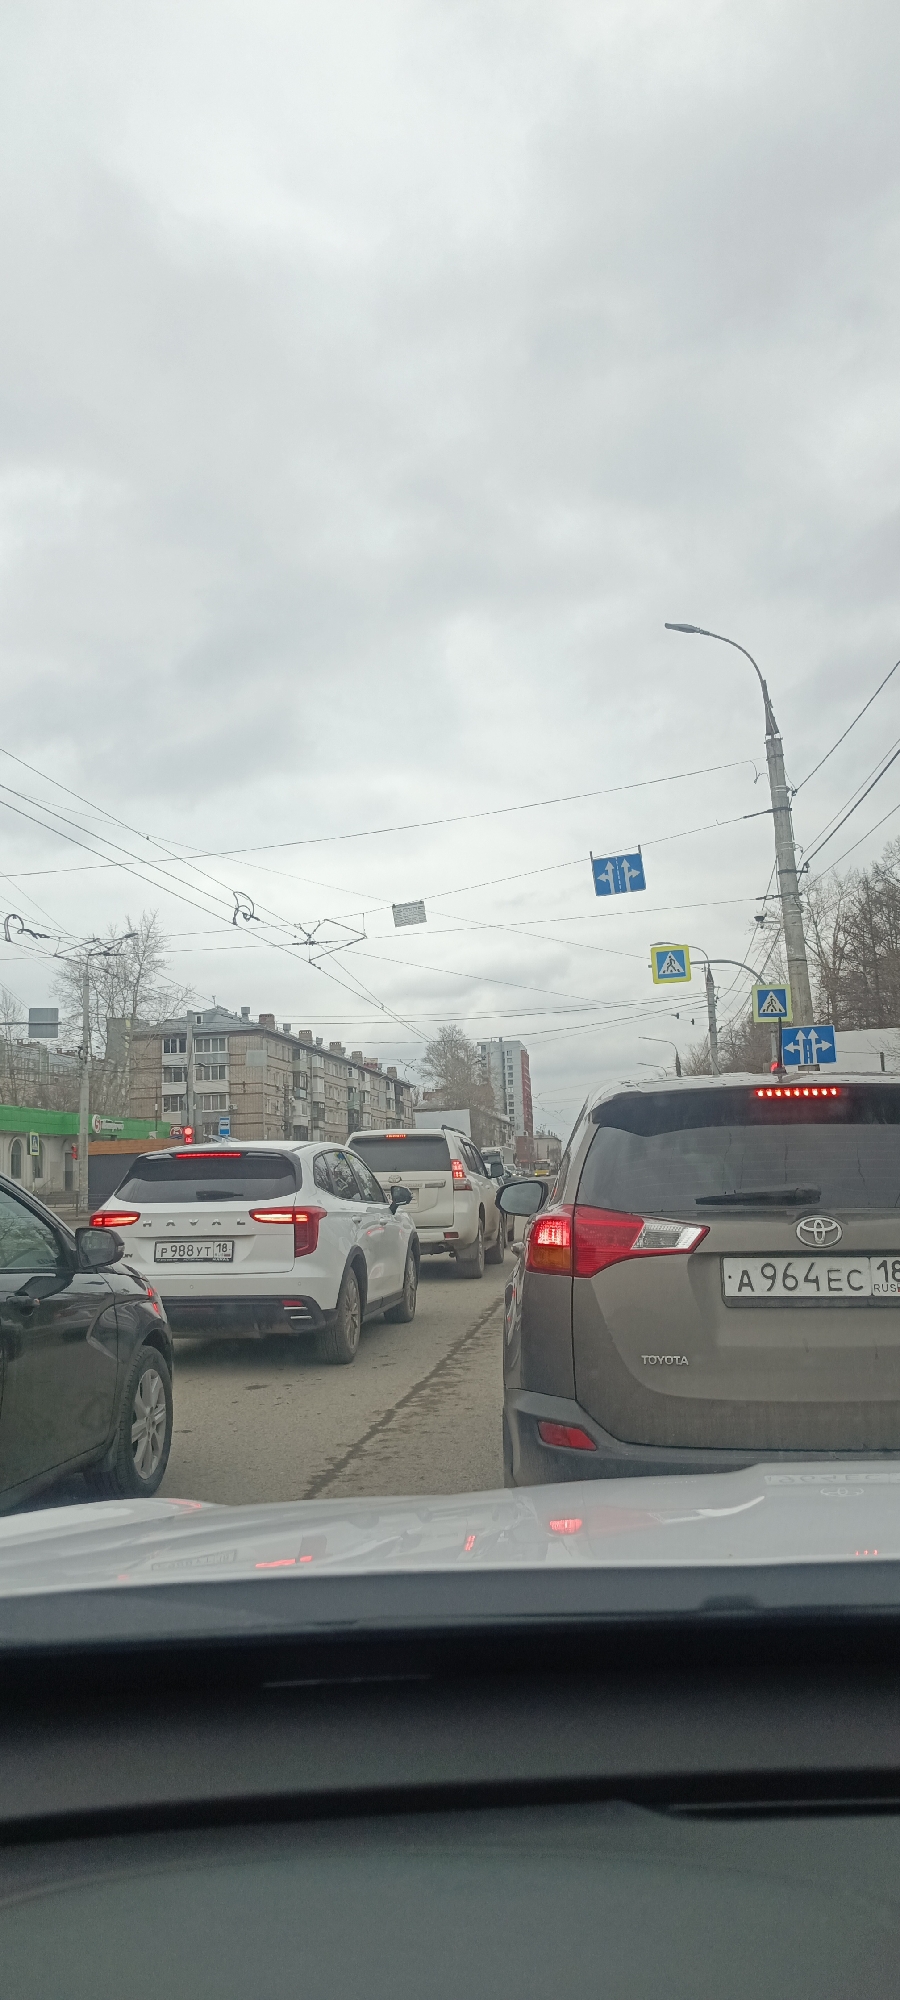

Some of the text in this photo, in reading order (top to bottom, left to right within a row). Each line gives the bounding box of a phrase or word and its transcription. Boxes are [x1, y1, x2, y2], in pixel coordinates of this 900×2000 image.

[142, 1218, 246, 1228] HAVAL
[216, 1243, 228, 1253] 18
[876, 1259, 900, 1283] 18
[873, 1283, 897, 1293] RUS
[641, 1355, 689, 1366] TOYOTA
